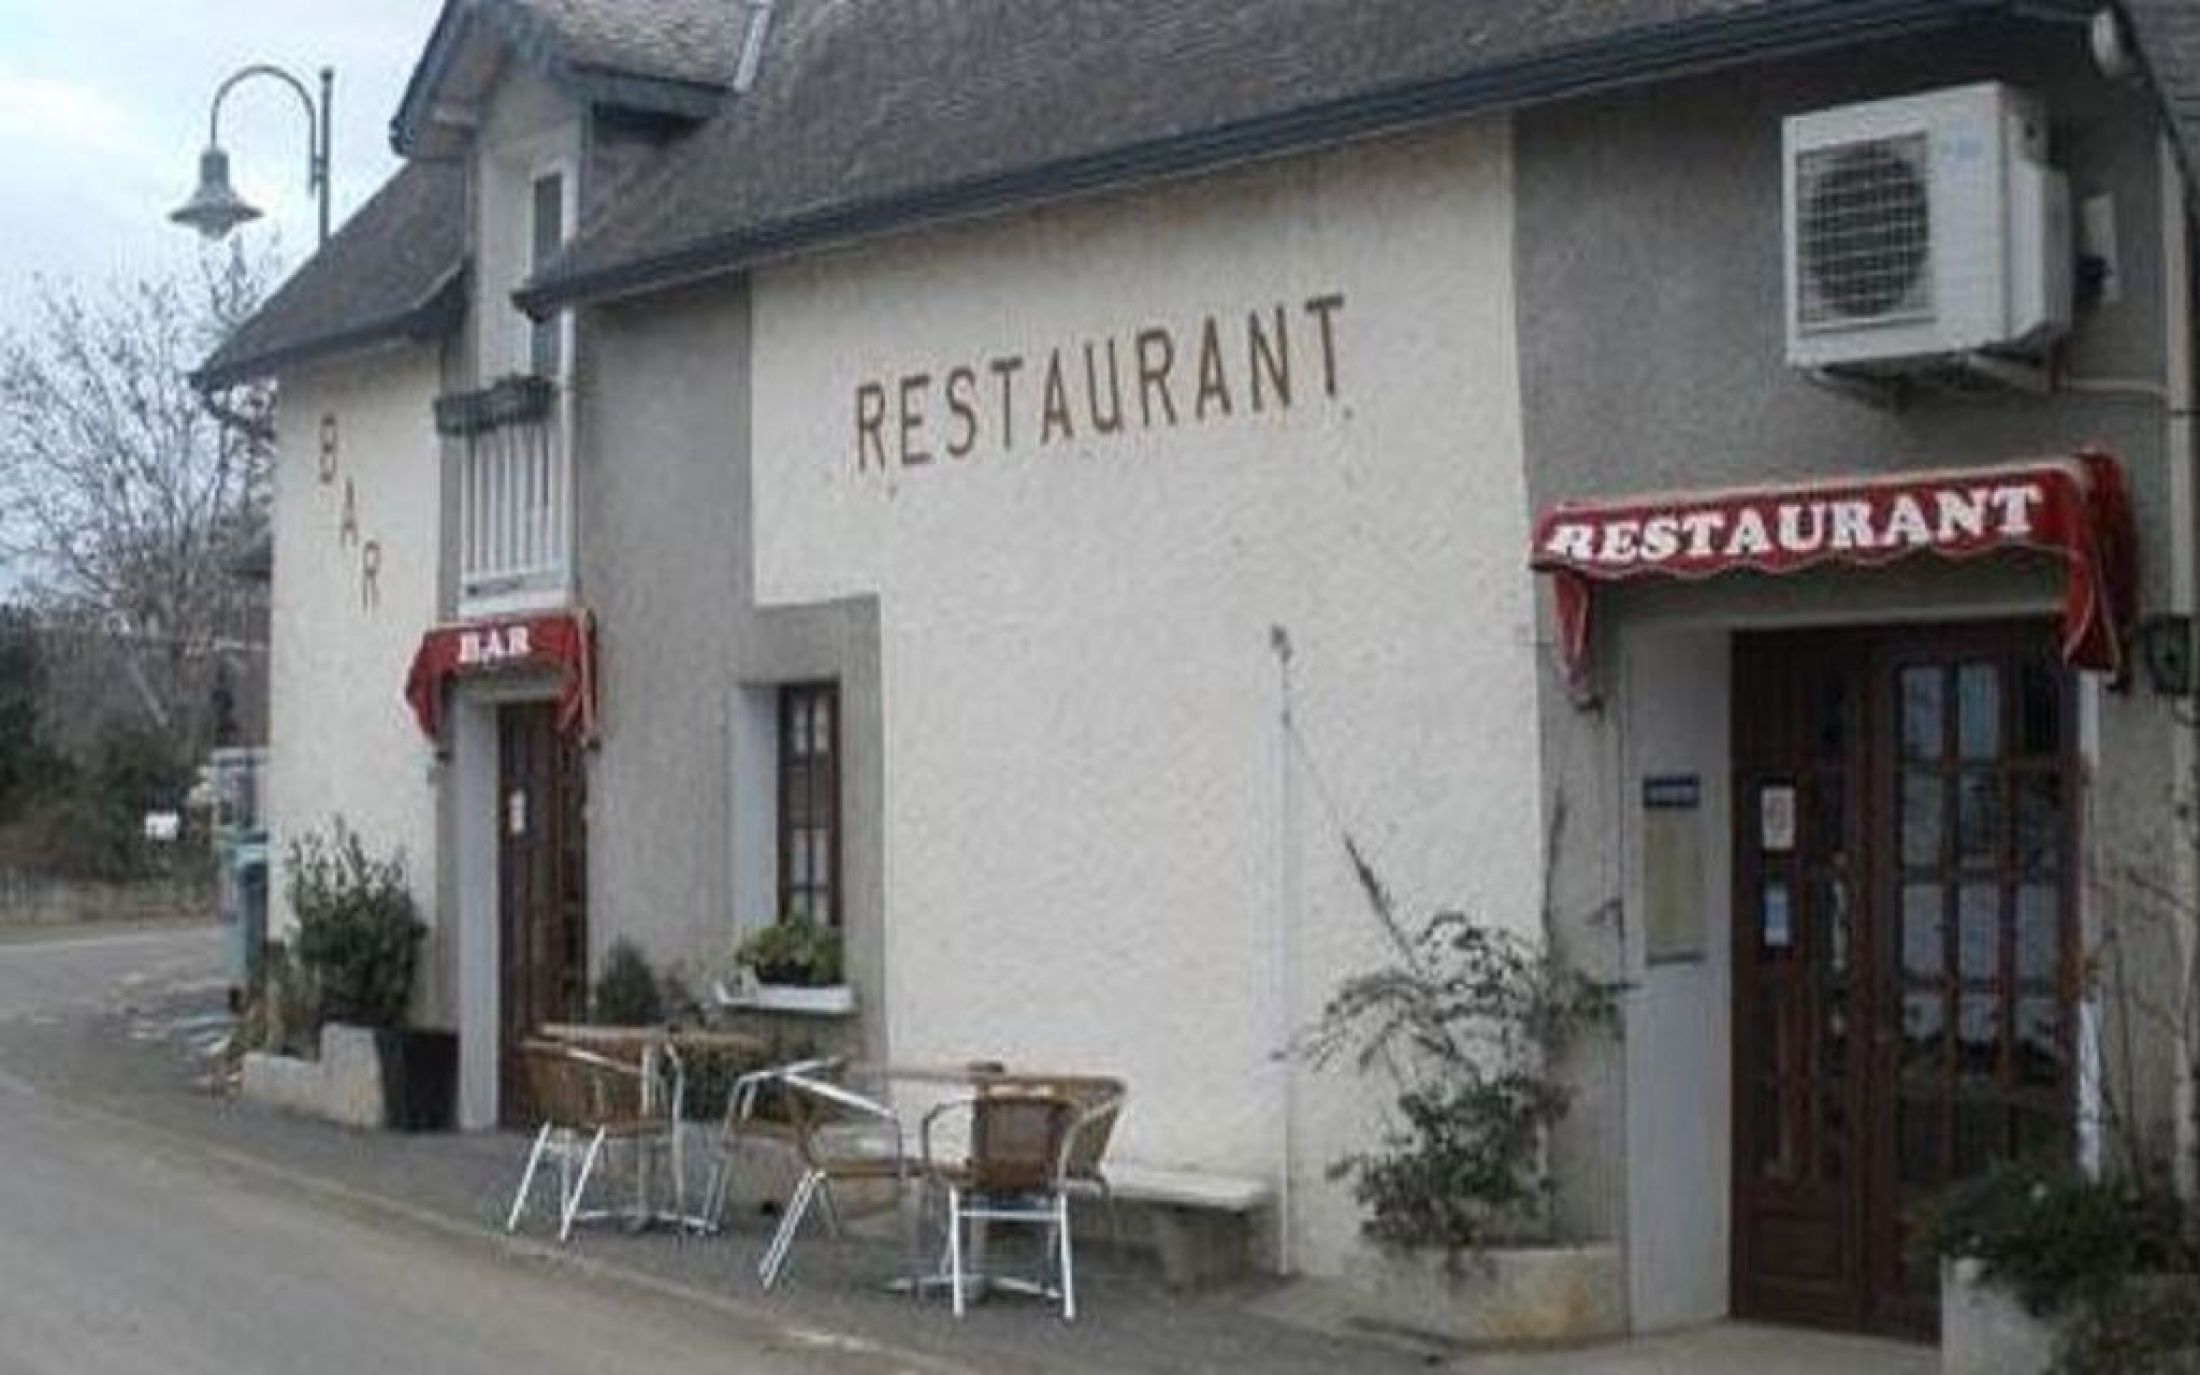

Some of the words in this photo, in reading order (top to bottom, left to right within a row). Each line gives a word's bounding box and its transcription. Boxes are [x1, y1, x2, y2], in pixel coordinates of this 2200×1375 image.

[856, 294, 1346, 471] RESTAURANT
[1546, 486, 2042, 561] RESTAURANT
[459, 626, 531, 663] BAR
